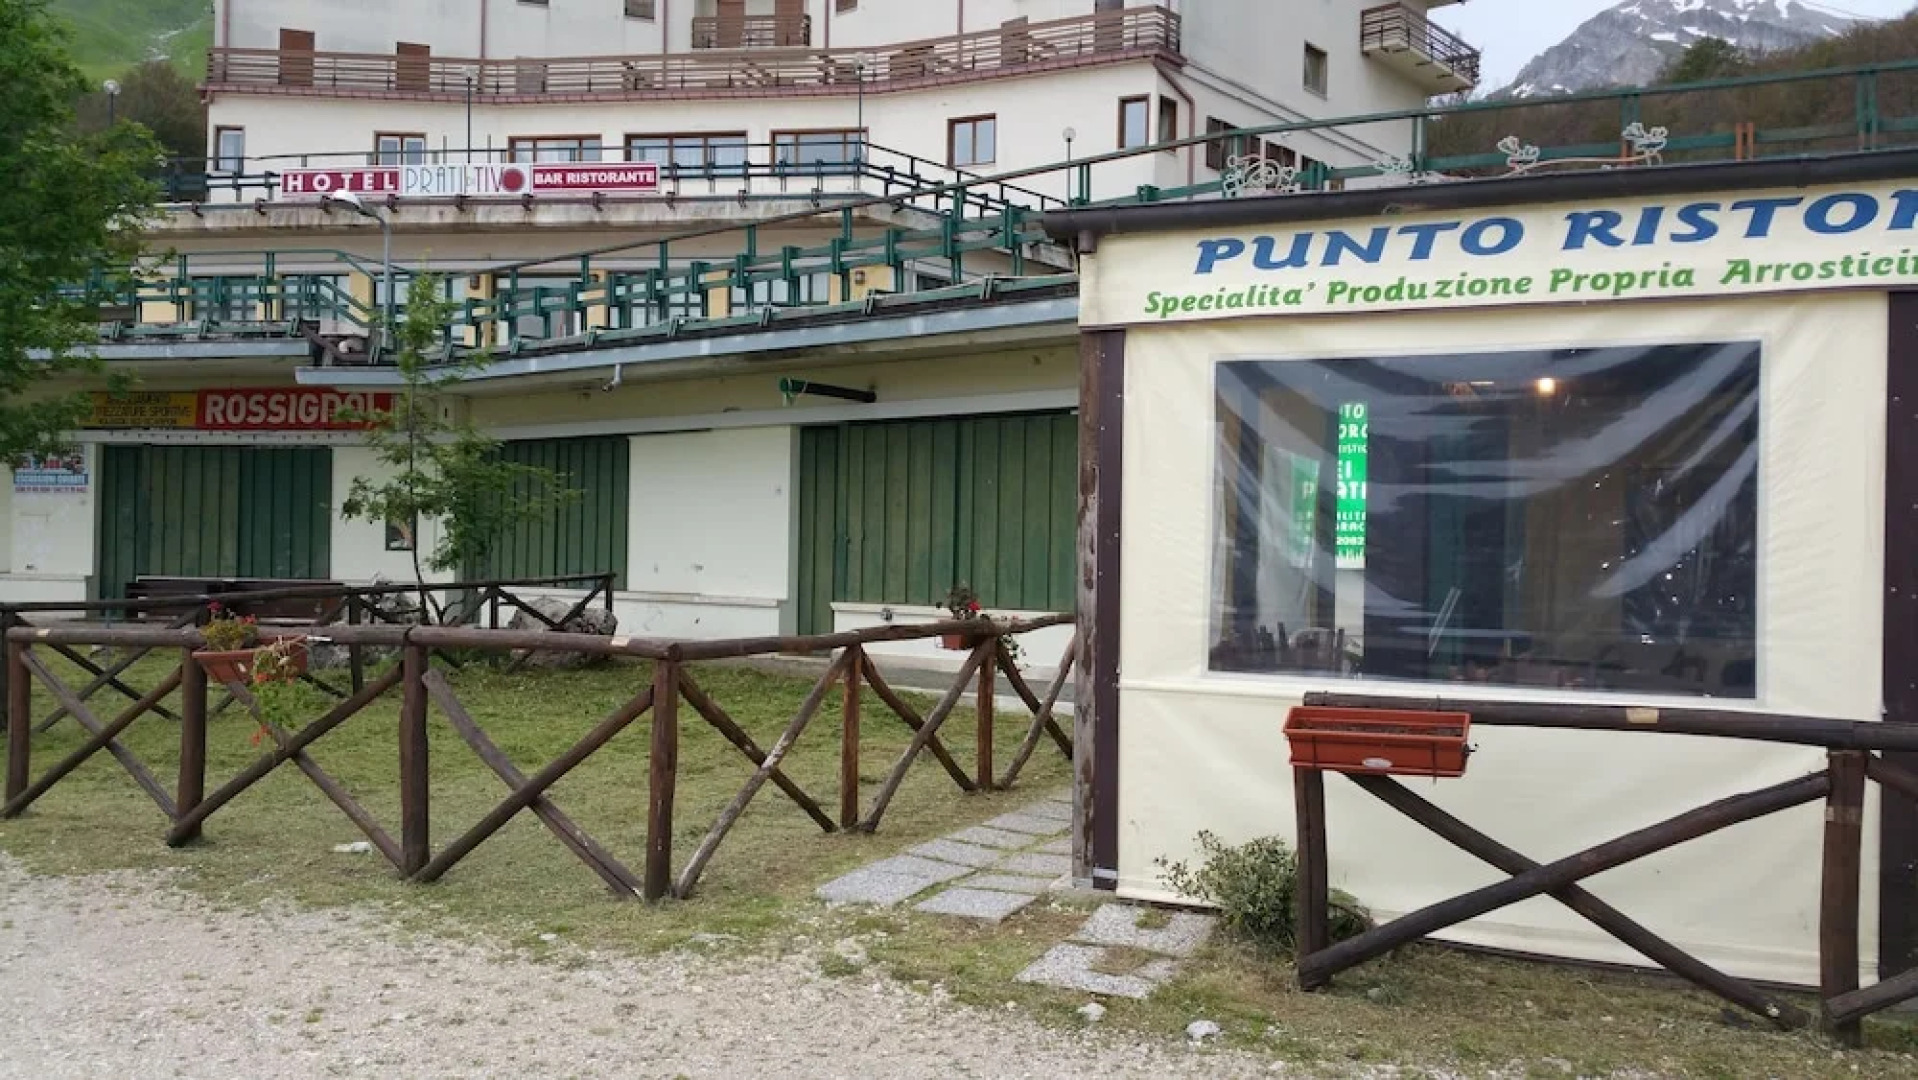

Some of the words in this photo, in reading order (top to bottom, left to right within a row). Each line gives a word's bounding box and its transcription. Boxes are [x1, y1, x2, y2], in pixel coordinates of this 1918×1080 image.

[286, 171, 395, 192] HOTEL
[534, 172, 563, 185] BAR
[566, 170, 655, 184] RISTORANTE
[1194, 215, 1525, 275] PUNTO
[1144, 281, 1317, 318] Specialita'
[1326, 271, 1533, 305] Produzione
[1548, 261, 1696, 297] Propria
[1718, 248, 1918, 285] Arrostici
